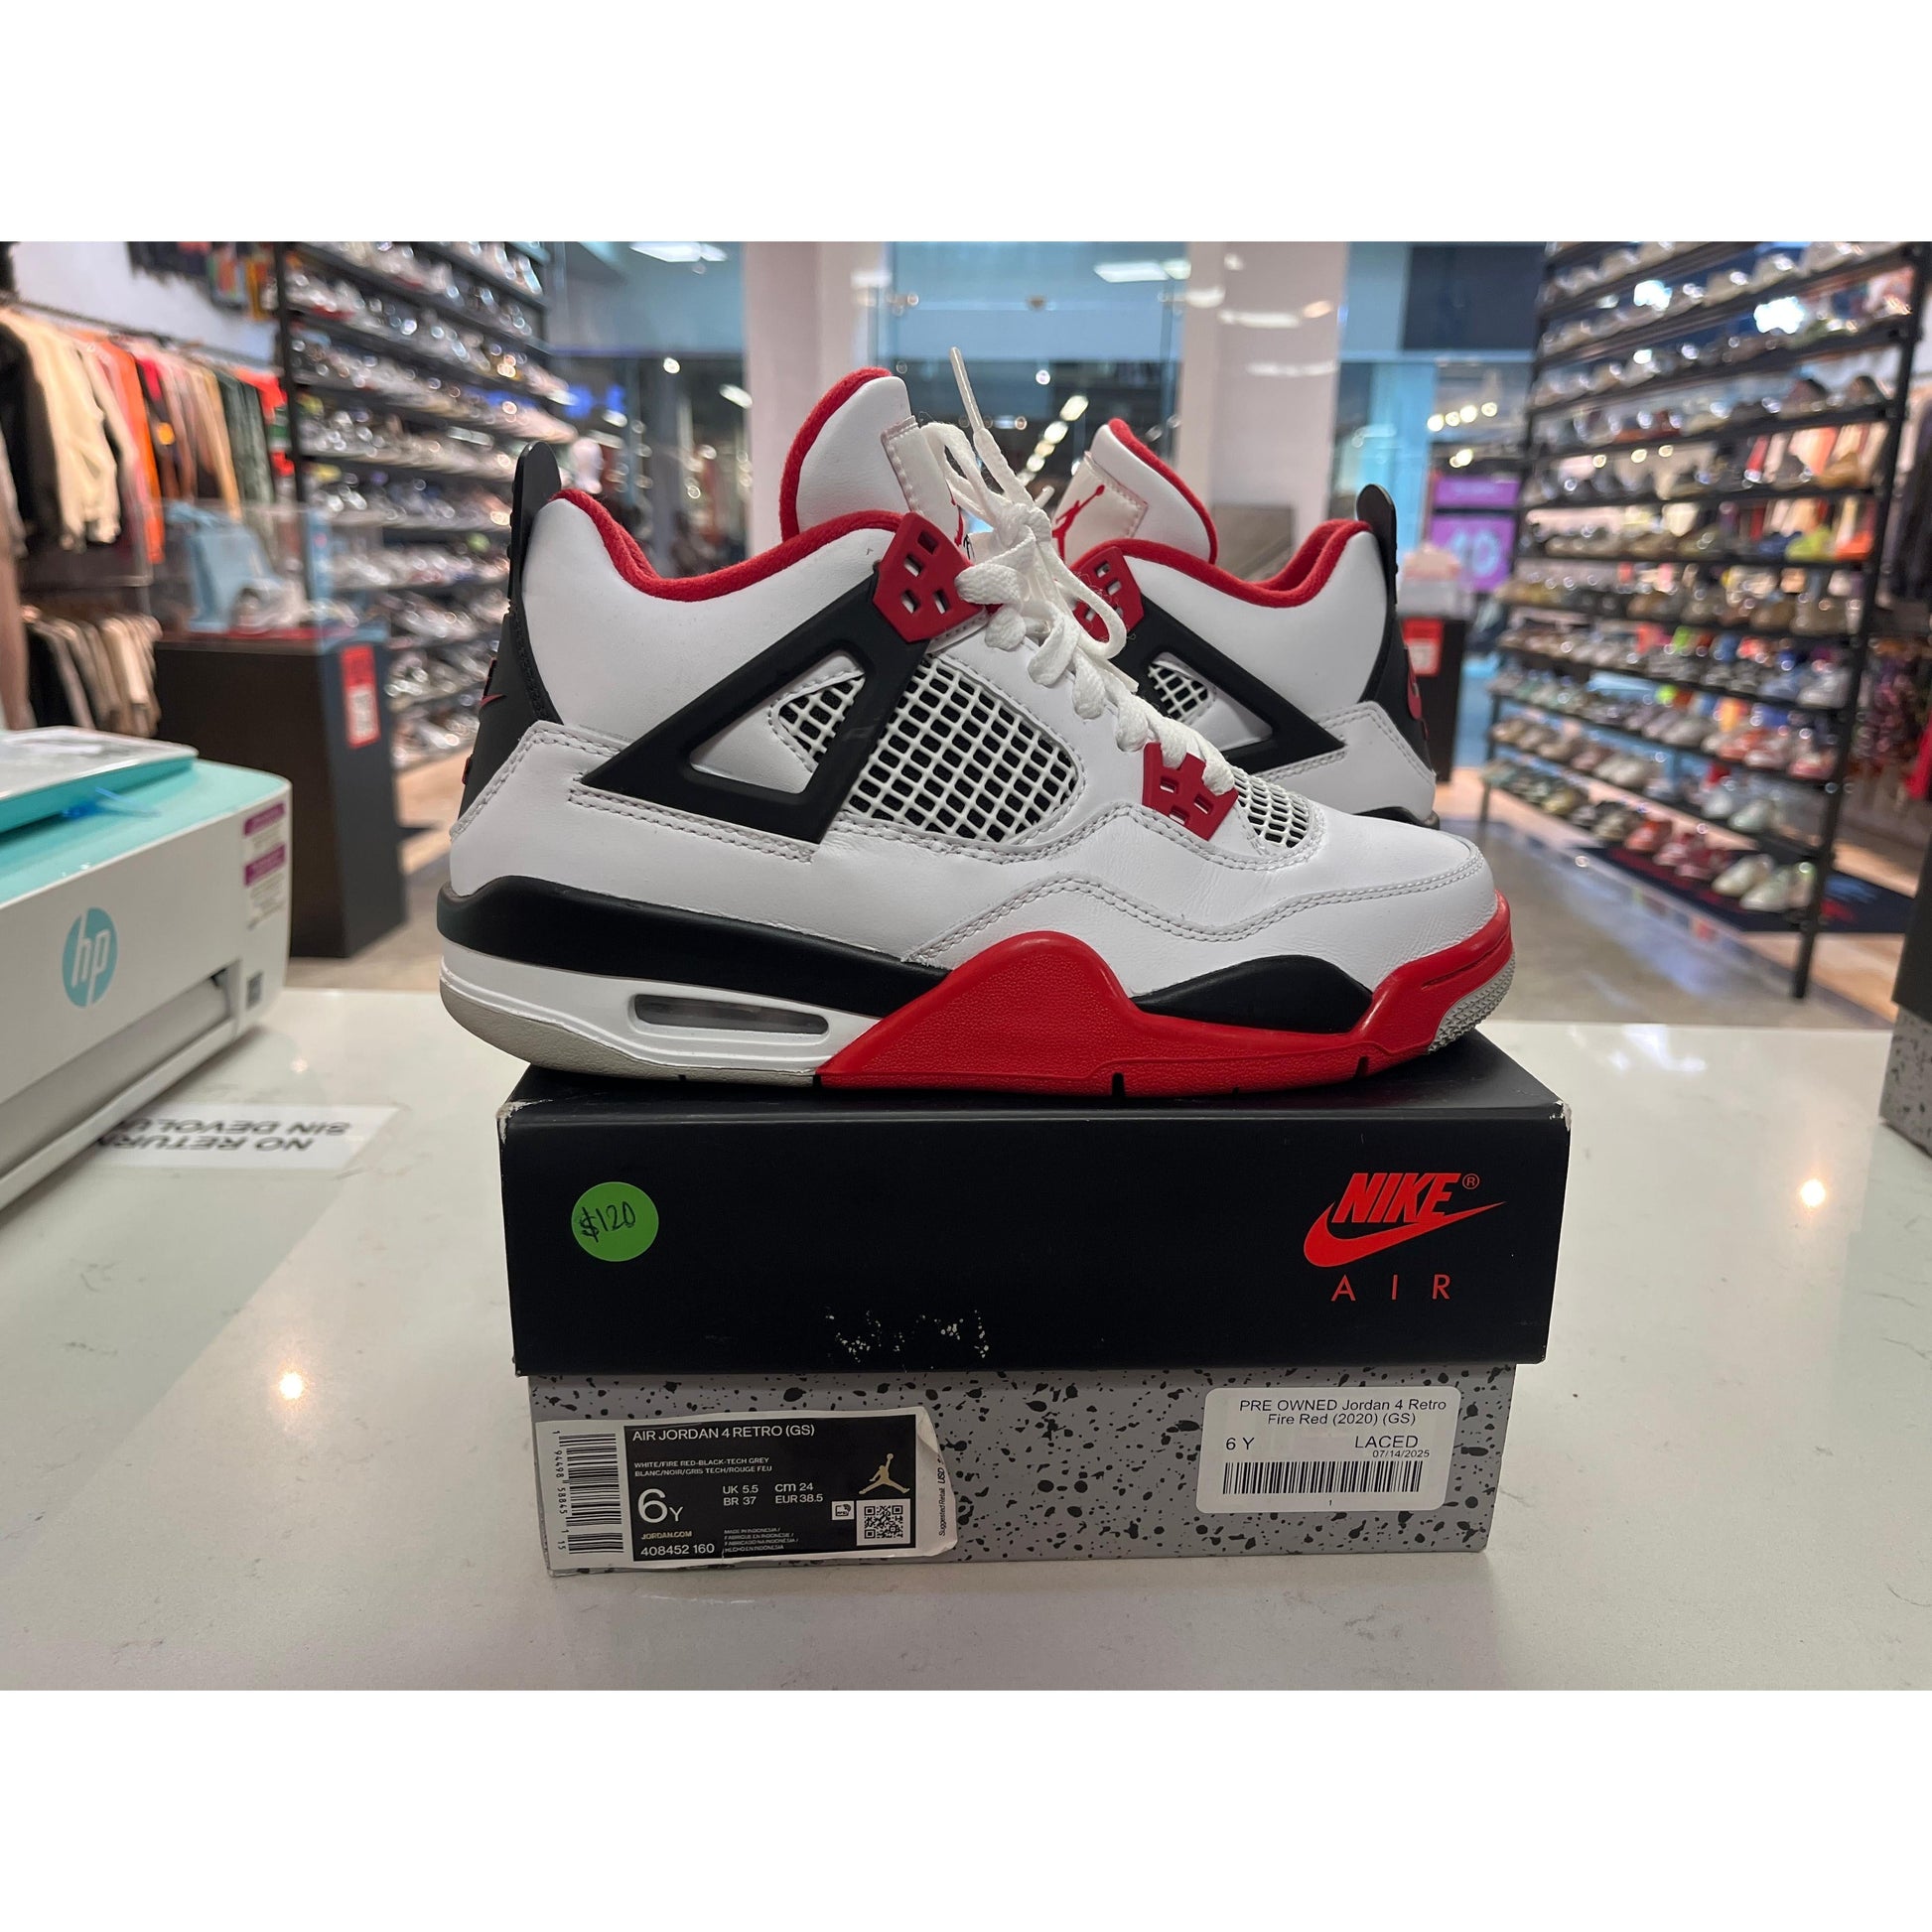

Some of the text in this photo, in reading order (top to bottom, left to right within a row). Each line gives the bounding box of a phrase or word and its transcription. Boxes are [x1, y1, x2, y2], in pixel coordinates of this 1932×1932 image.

[286, 1120, 351, 1136] SIN
[255, 1136, 314, 1153] NO
[1330, 1172, 1462, 1224] NIKE
[579, 1200, 636, 1243] $120
[1330, 1274, 1452, 1303] AIR
[1239, 1398, 1448, 1412] PRE OWNED Jordan 4 Retro
[1267, 1412, 1418, 1427] Fire Red (2020) (GS)
[632, 1424, 815, 1442] AIR JORDAN 4 RETRO (GS)
[1225, 1437, 1256, 1451] 6 Y
[1354, 1435, 1420, 1449] LACED
[1372, 1449, 1431, 1458] 07/14/2025
[633, 1460, 679, 1469] WHITE/FIRE
[634, 1467, 704, 1477] BLANC/NOIR/GRIS
[705, 1465, 756, 1474] TECH/ROUGE
[937, 1466, 946, 1484] USD
[722, 1484, 759, 1495] UK 5.5
[774, 1482, 814, 1493] cm 24
[723, 1496, 757, 1506] BR 37
[775, 1493, 824, 1504] EUR 38.5
[938, 1505, 947, 1537] Suggested
[640, 1530, 693, 1540] JORDAN.COM
[640, 1543, 716, 1557] 408452 160
